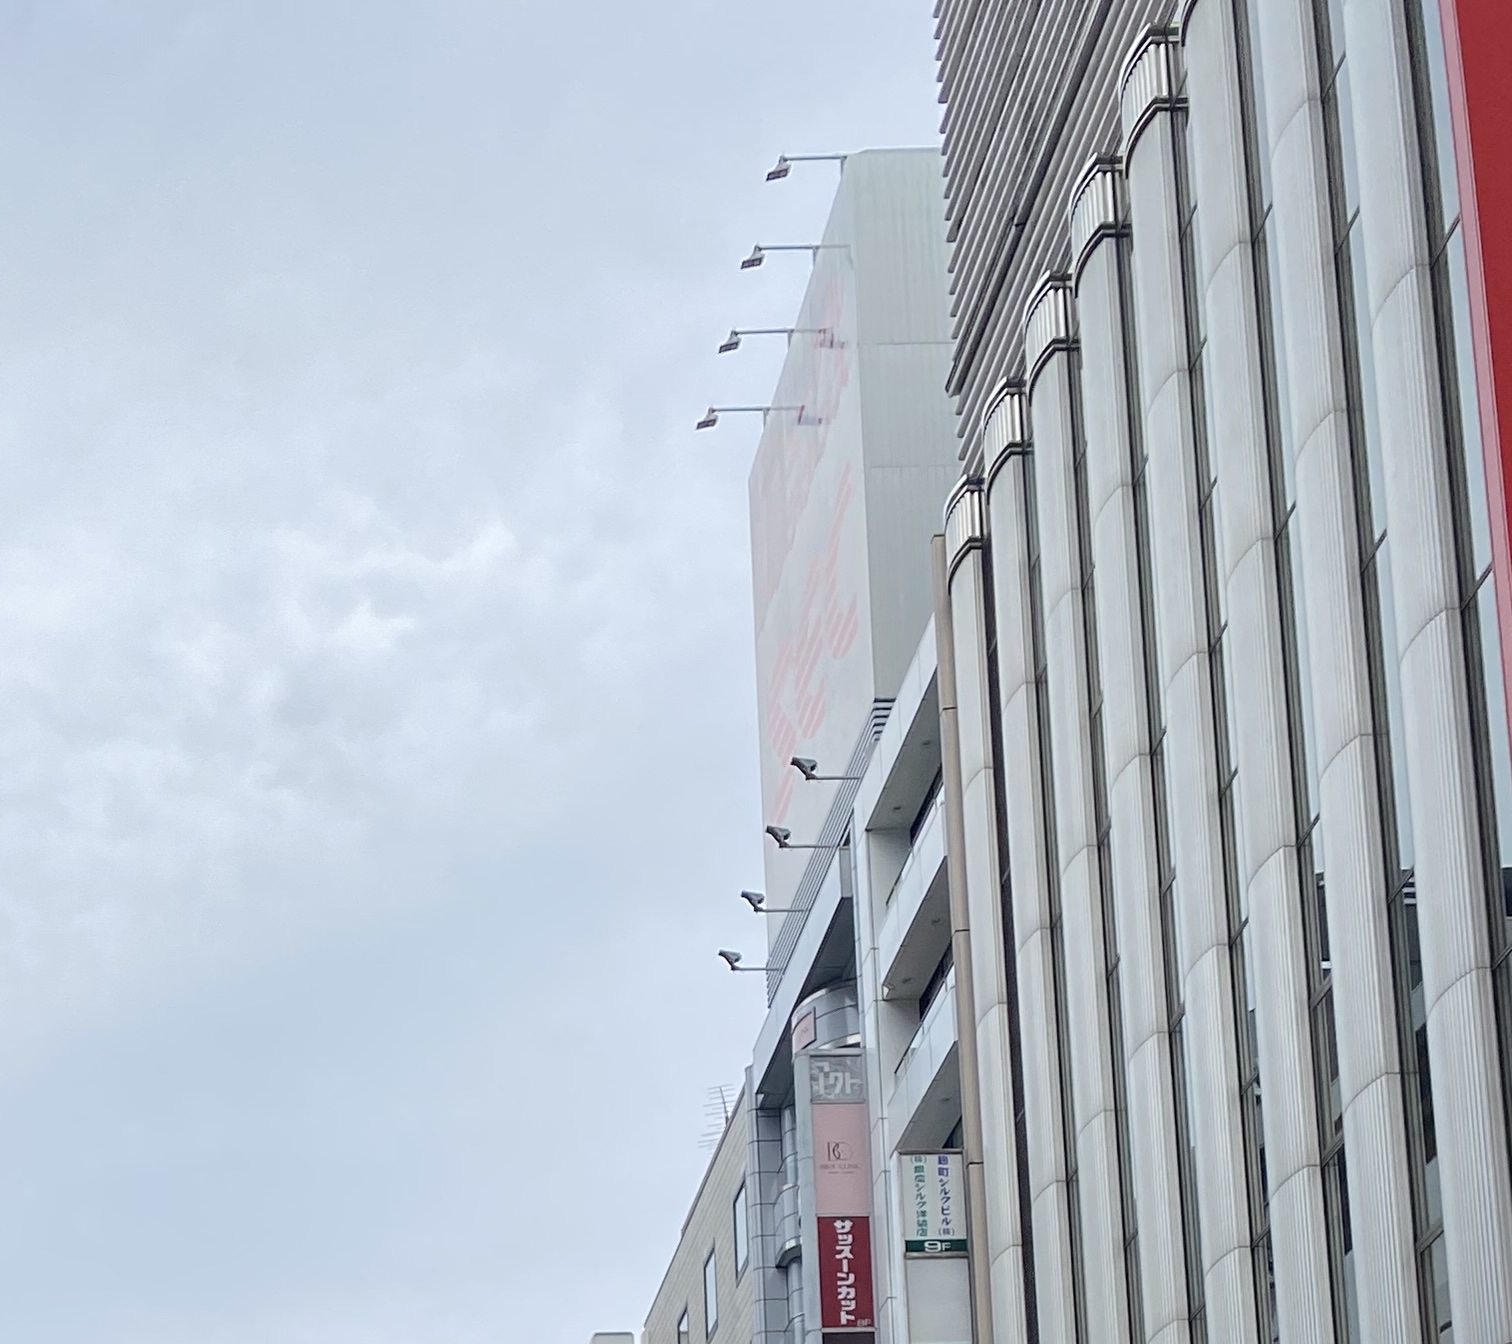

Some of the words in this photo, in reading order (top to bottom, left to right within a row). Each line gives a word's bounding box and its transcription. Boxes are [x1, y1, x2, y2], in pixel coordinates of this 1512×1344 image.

[833, 1219, 857, 1326] サッスーンカット
[924, 1240, 951, 1252] 9F
